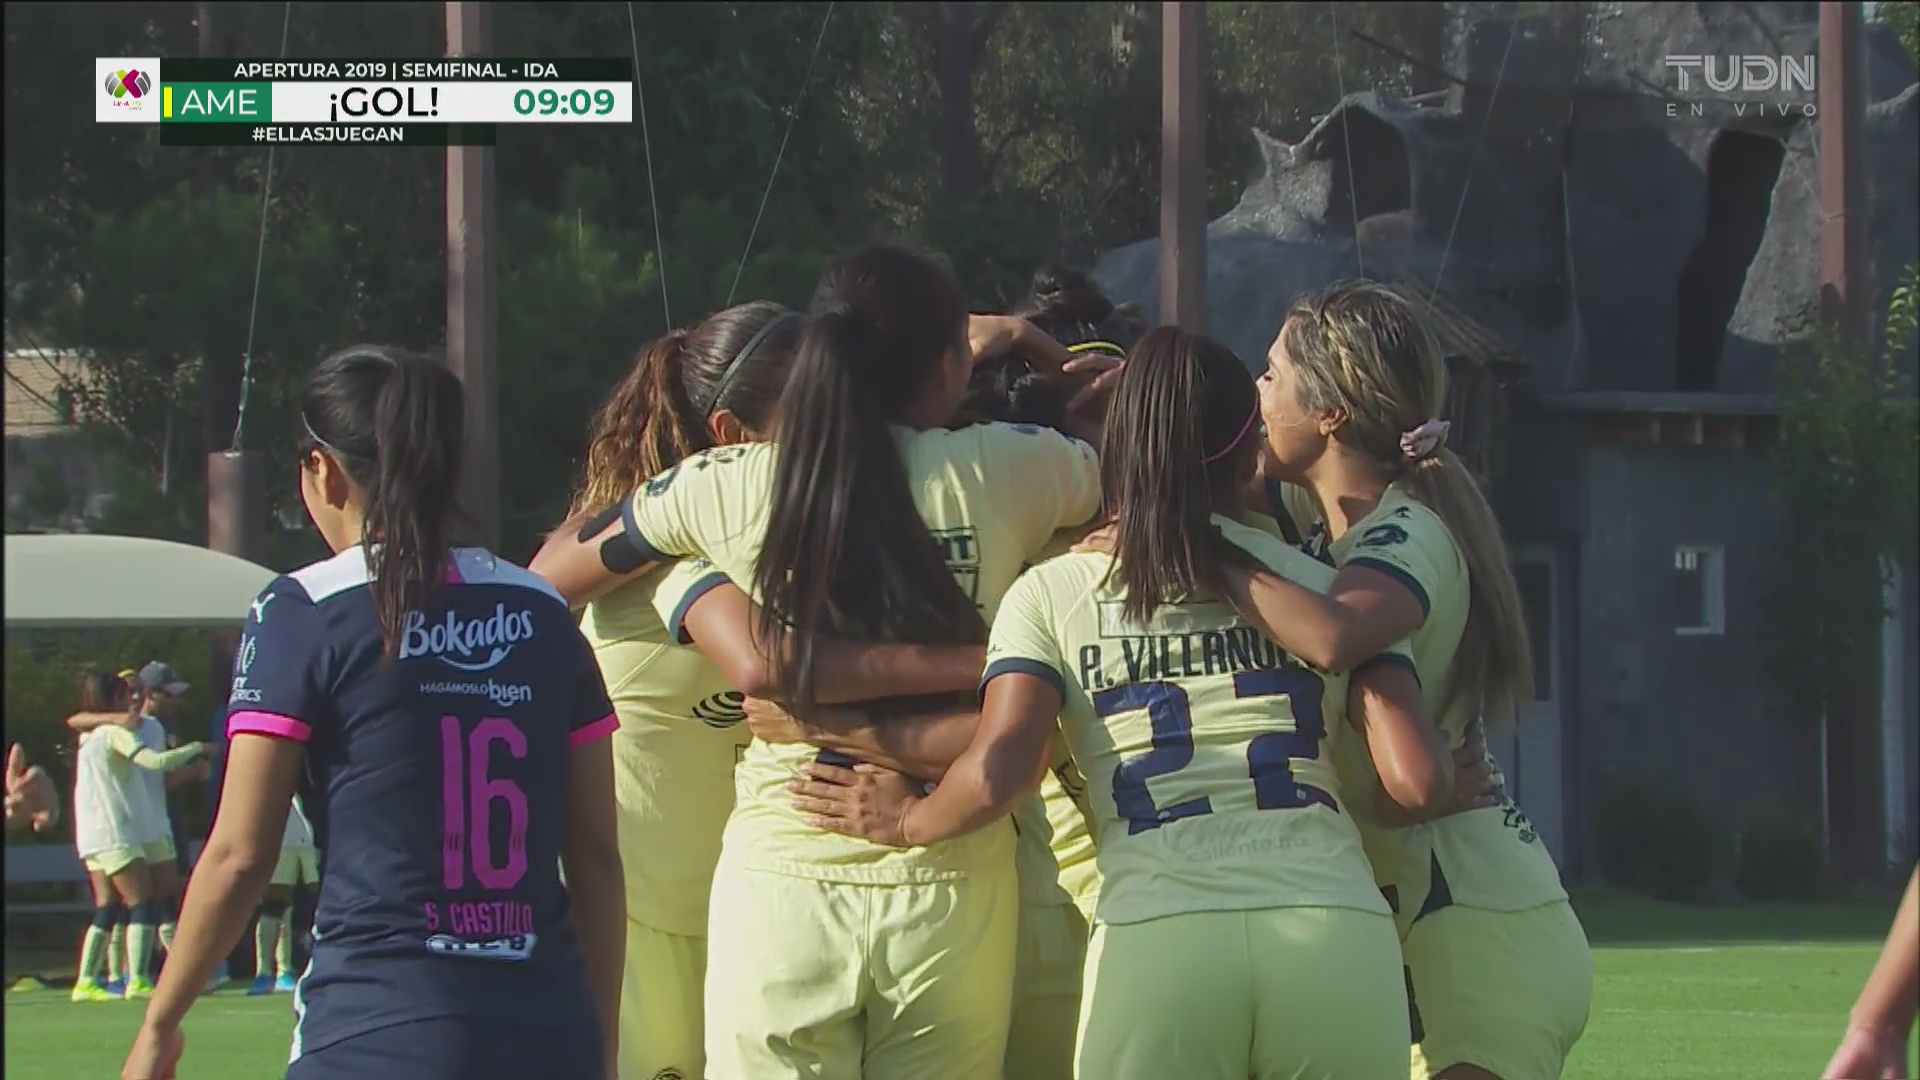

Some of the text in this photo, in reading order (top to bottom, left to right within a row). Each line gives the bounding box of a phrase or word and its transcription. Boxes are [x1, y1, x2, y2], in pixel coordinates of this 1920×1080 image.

[399, 603, 534, 660] Bokados
[441, 715, 529, 890] 16
[1091, 667, 1340, 836] 22
[424, 901, 534, 938] S CASTILLO
